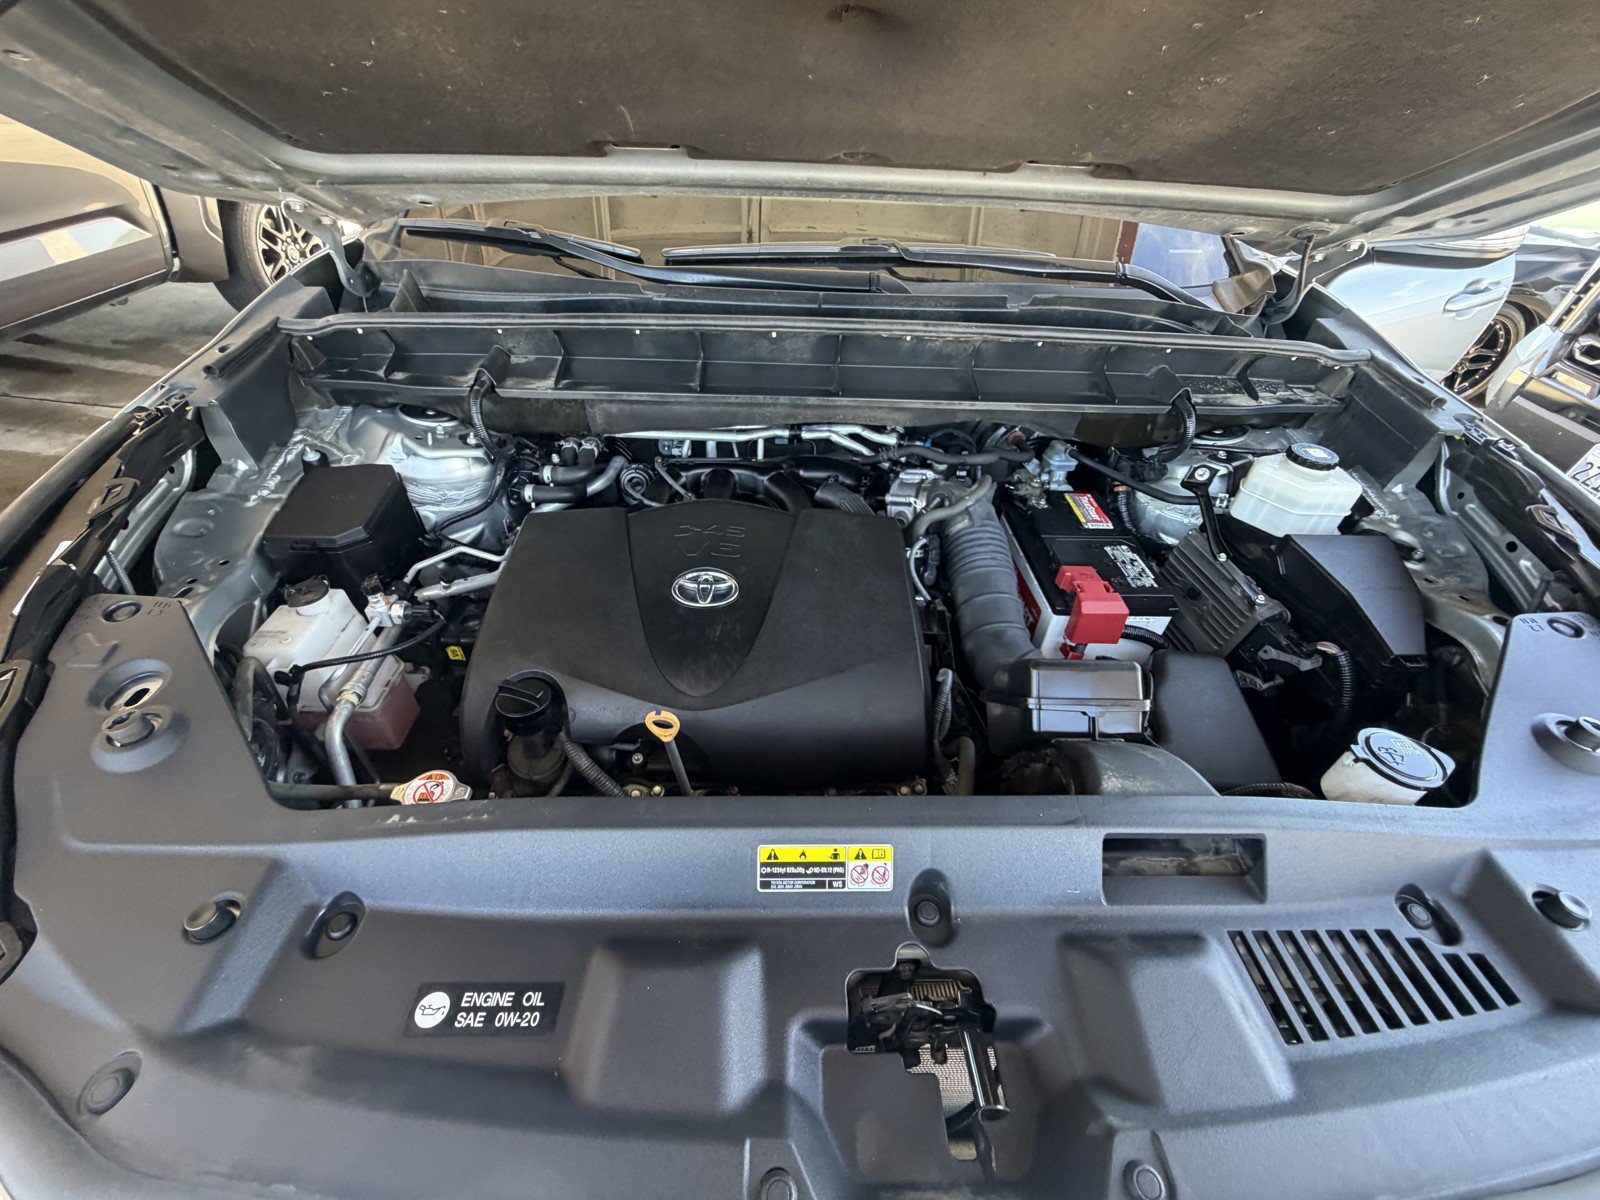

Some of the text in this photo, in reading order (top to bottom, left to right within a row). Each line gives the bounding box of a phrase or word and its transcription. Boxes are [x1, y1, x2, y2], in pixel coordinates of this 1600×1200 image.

[1571, 462, 1600, 493] 22
[832, 880, 843, 888] WS
[460, 991, 545, 1007] ENGINE OIL
[454, 1011, 540, 1028] SAE 0W-20
